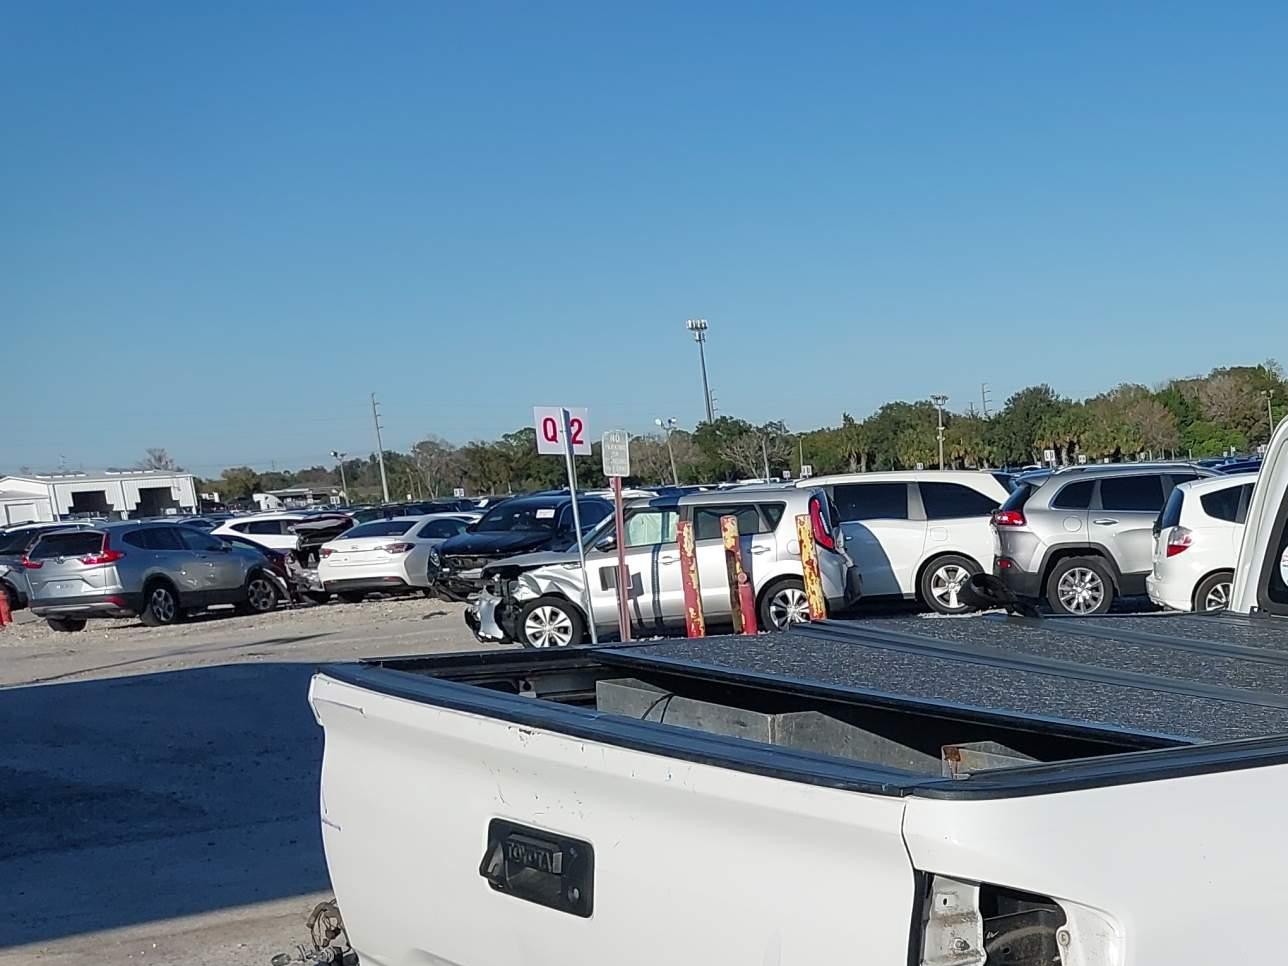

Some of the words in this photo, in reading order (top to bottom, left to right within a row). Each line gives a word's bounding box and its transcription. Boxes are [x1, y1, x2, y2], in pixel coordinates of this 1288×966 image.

[542, 417, 558, 443] Q
[570, 418, 584, 445] 2
[506, 842, 553, 873] TOYOTA
